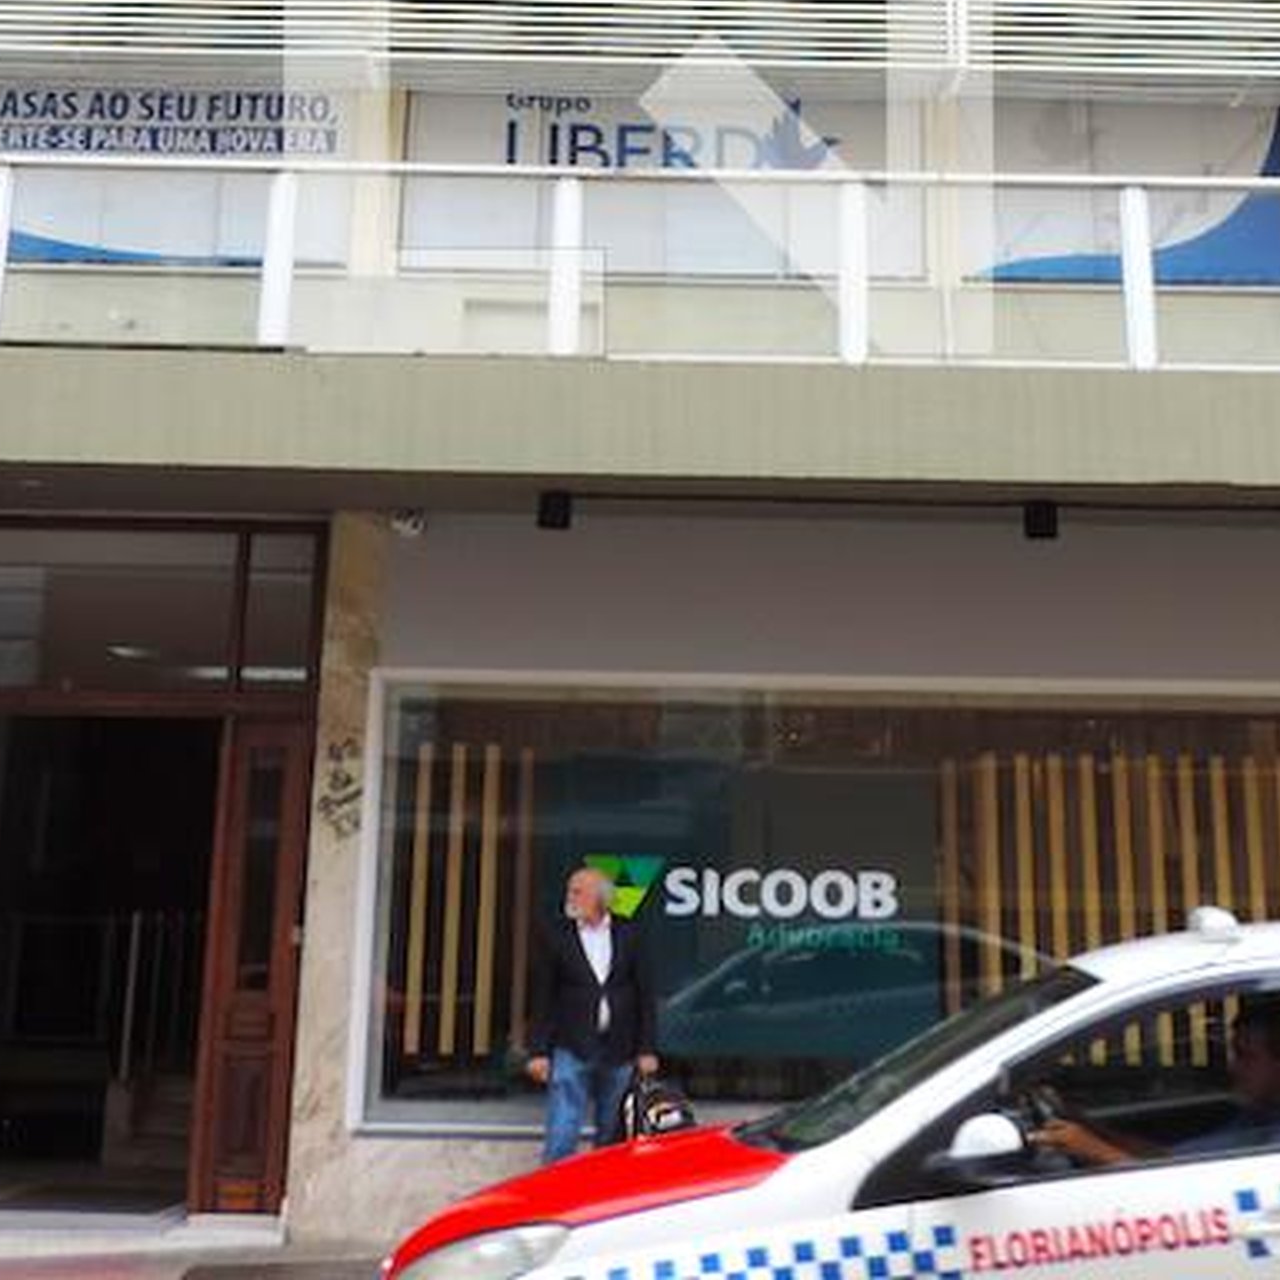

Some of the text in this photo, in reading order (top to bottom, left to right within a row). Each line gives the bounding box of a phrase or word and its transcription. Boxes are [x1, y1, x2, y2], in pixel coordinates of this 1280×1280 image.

[0, 89, 79, 119] ASAS
[87, 91, 131, 120] AO
[137, 91, 198, 121] SEU
[91, 125, 152, 153] PARA
[158, 128, 211, 153] UMA
[664, 867, 899, 919] SICOOB
